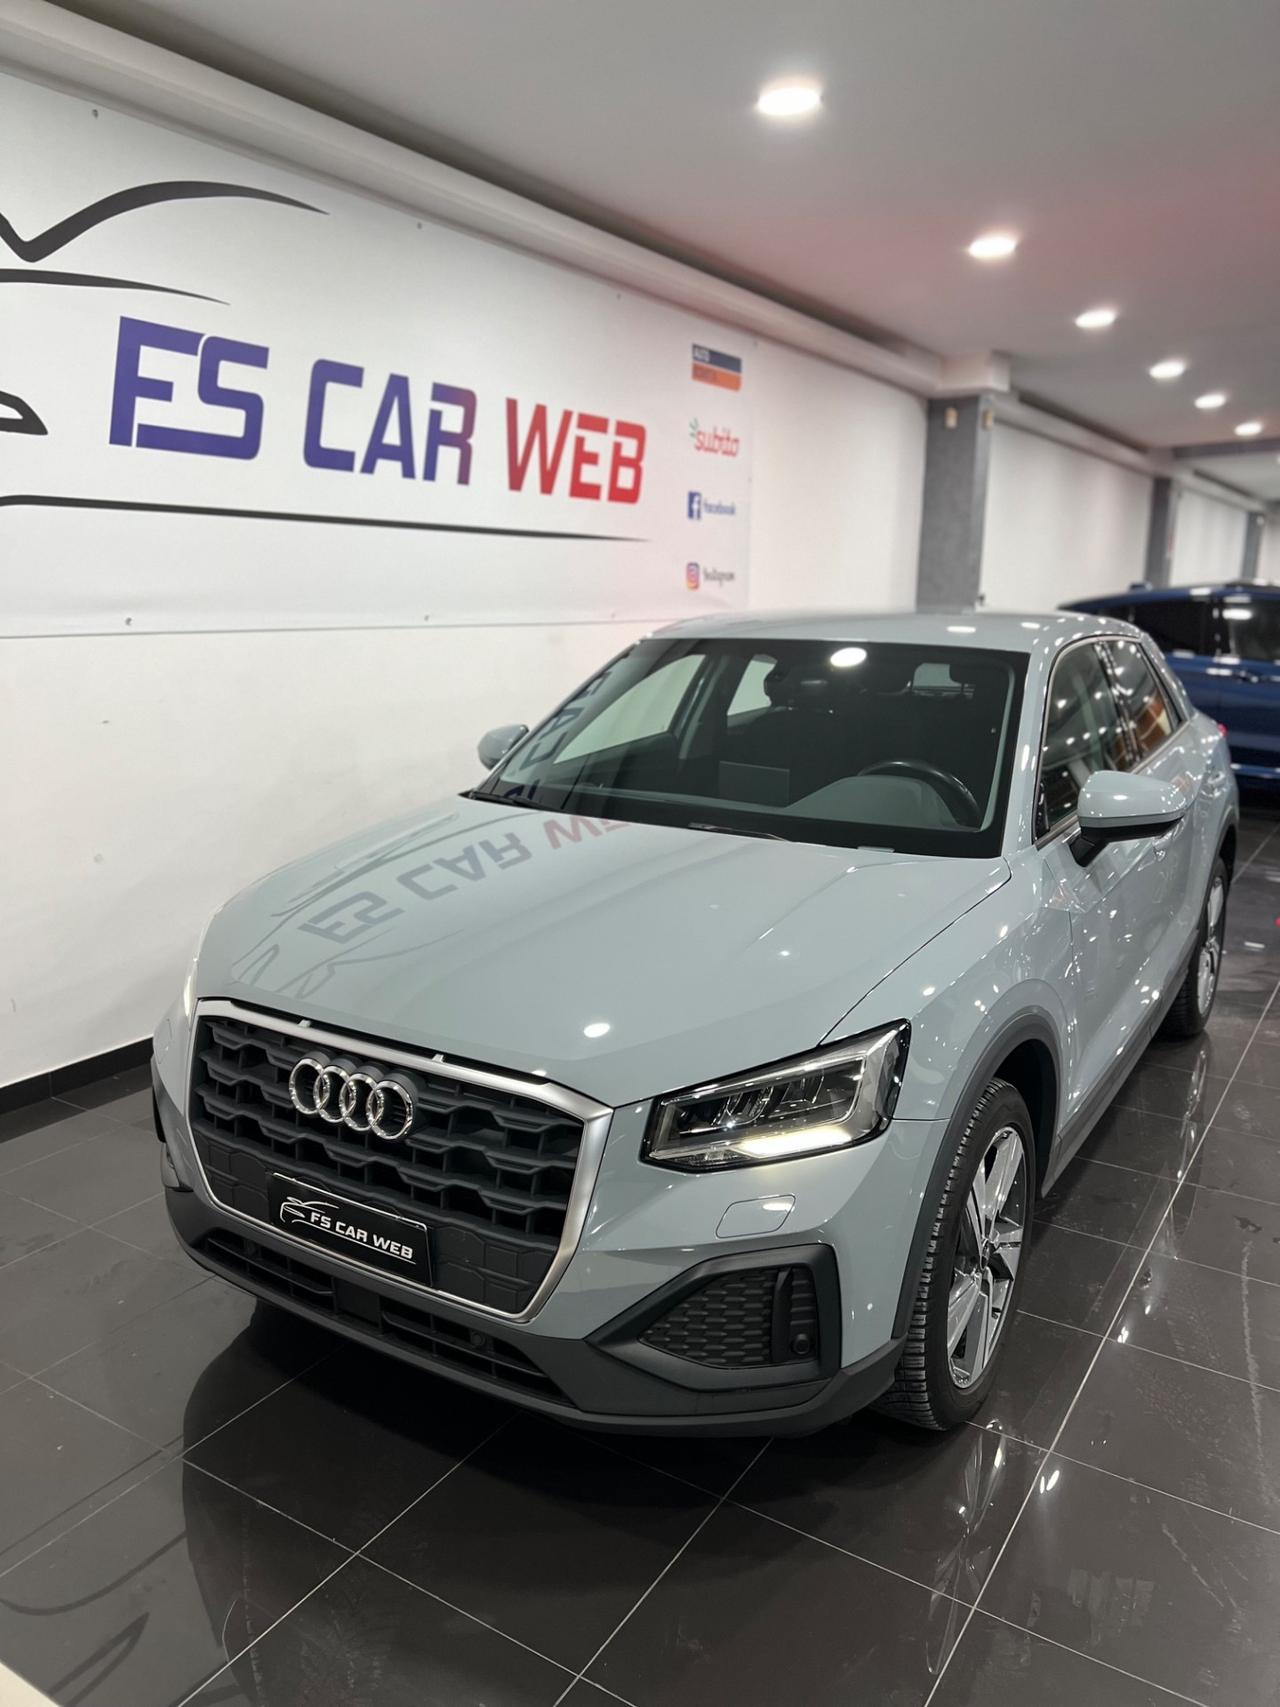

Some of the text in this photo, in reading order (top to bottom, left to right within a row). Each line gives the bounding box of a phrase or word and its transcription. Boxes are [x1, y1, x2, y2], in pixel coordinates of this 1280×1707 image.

[109, 316, 647, 504] FS CAR WEB
[310, 1211, 413, 1260] FS CAR WEB
